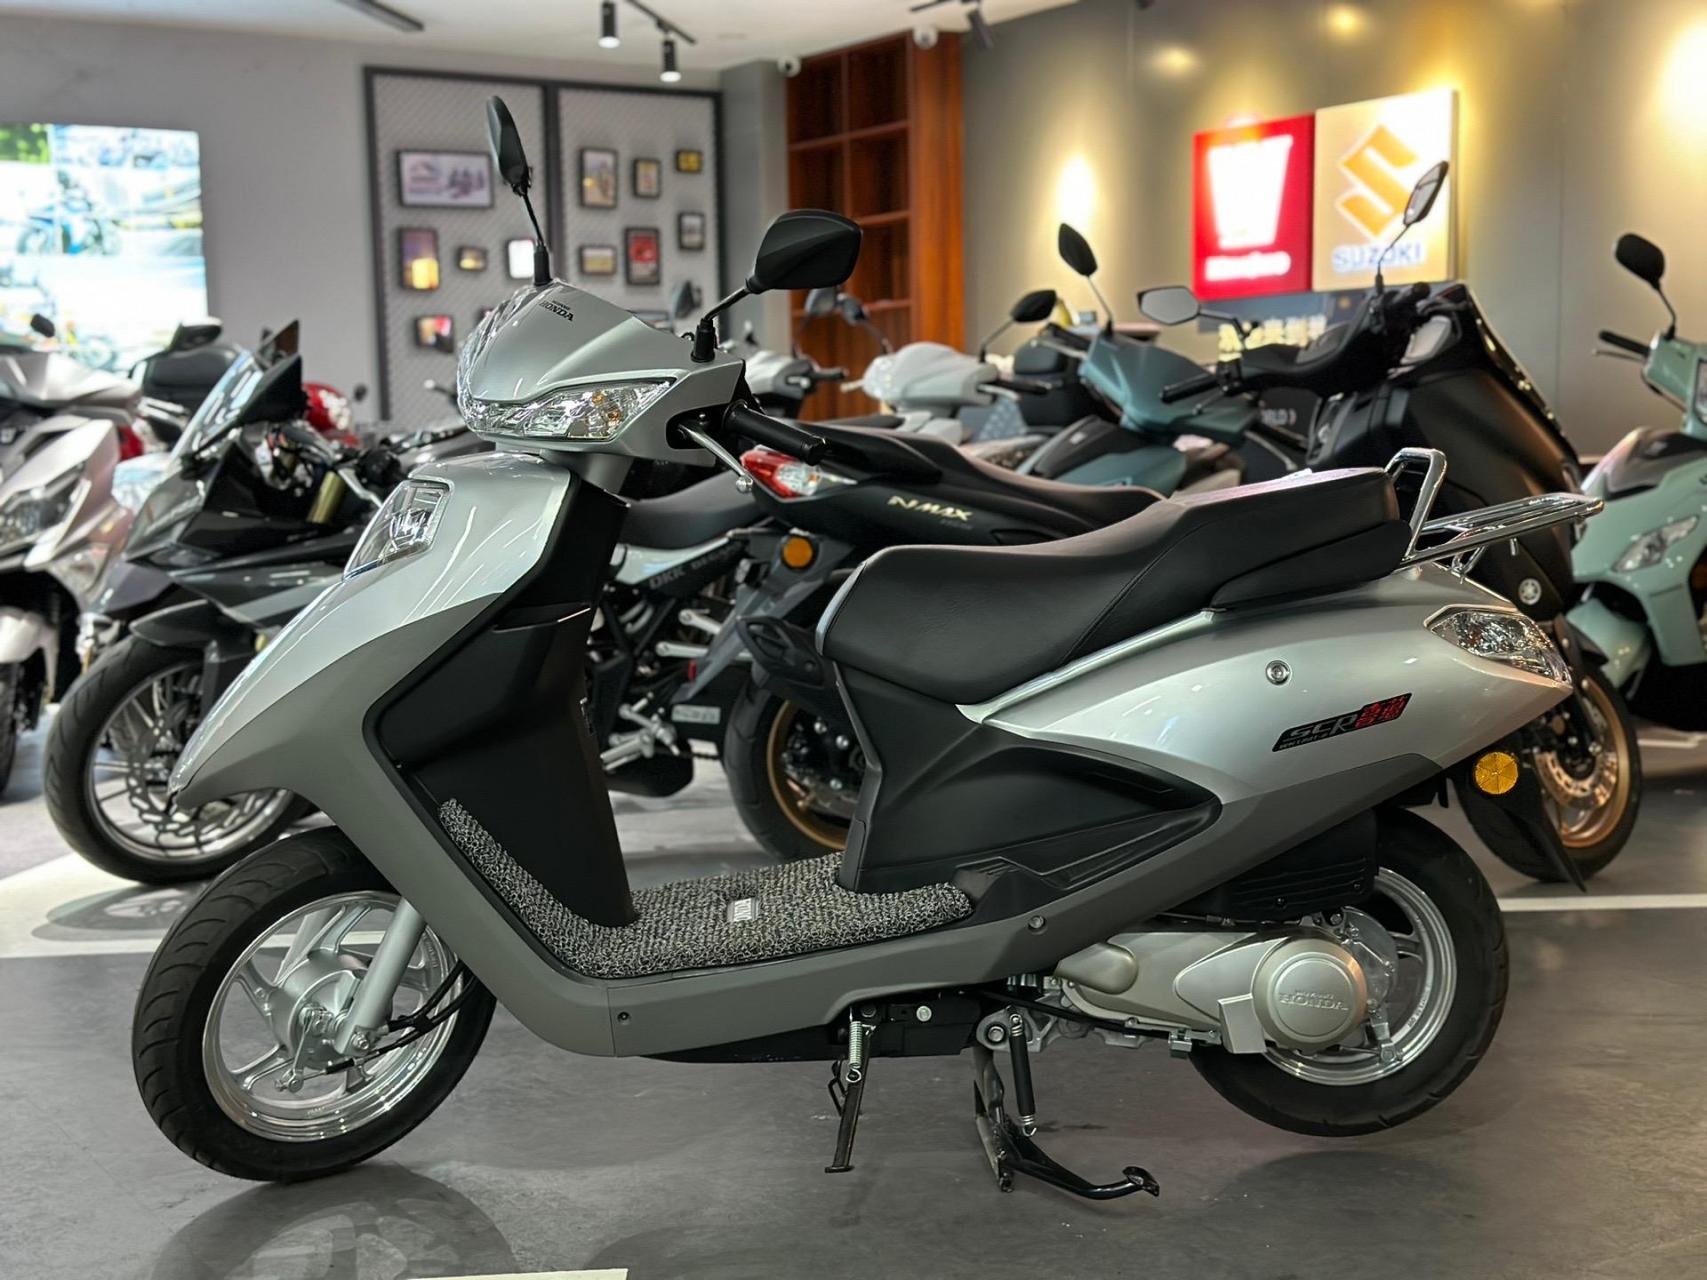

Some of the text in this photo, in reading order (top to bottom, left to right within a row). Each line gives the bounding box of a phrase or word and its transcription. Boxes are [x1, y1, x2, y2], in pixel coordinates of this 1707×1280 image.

[539, 300, 574, 321] HONDA
[887, 495, 973, 521] NMAX
[1280, 992, 1349, 1011] HONDA
